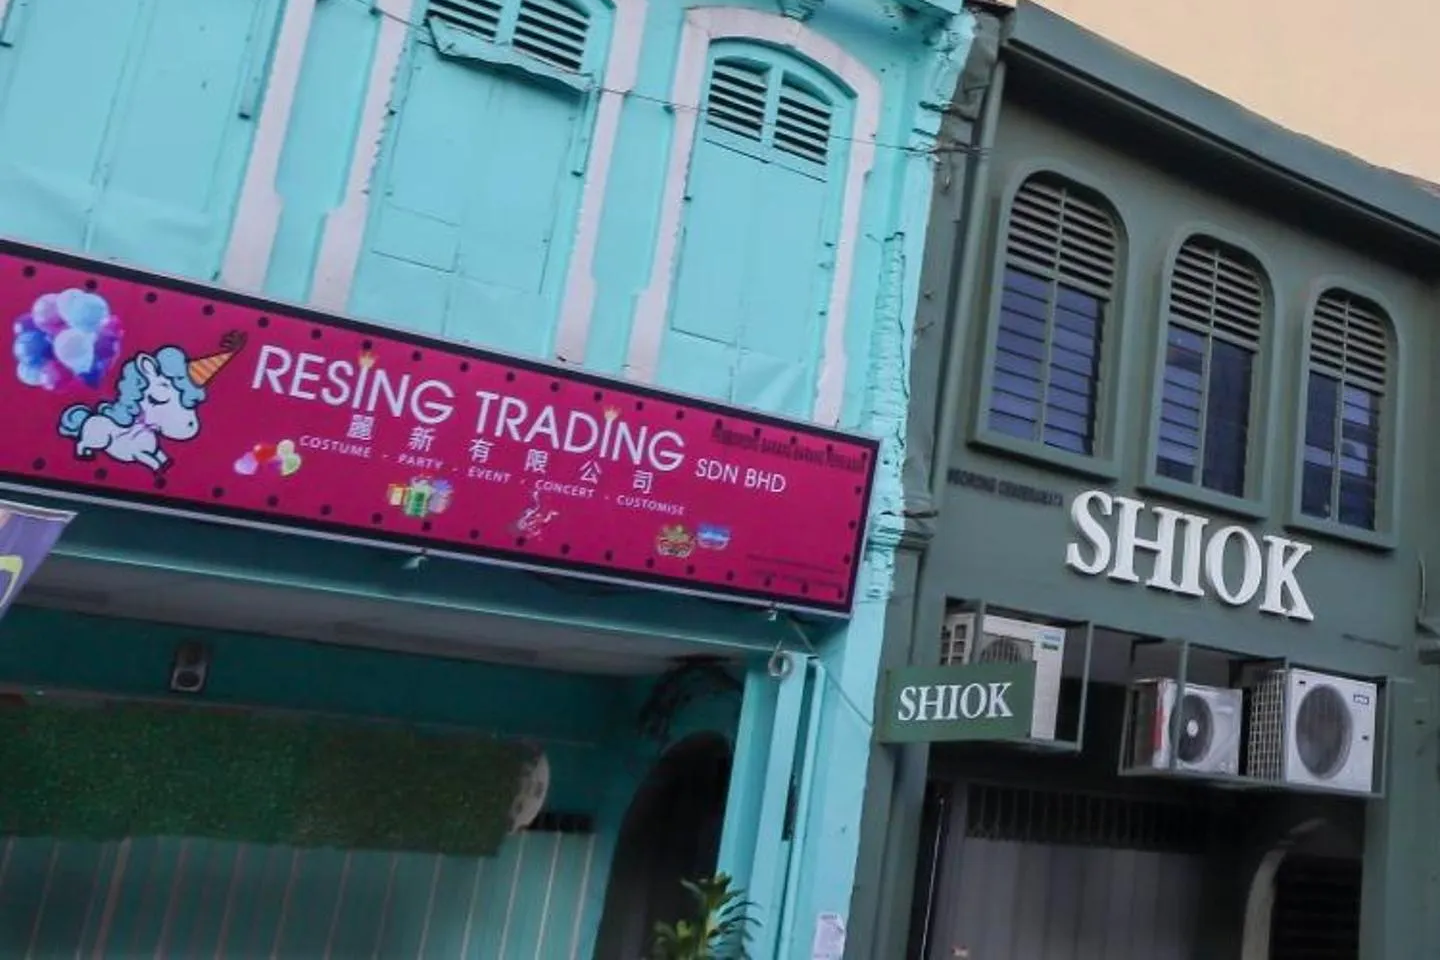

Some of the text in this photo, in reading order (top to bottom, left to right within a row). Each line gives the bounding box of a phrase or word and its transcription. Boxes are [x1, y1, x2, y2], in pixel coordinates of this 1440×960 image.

[252, 344, 455, 424] RESING
[476, 391, 685, 472] TRADING
[695, 458, 739, 484] SDN
[744, 467, 787, 493] BHD
[300, 435, 685, 516] COSTUME PARTY EVENT CONCERT CUSTOMISE
[1065, 489, 1315, 622] SHIOK
[898, 681, 1013, 724] SHIOK
